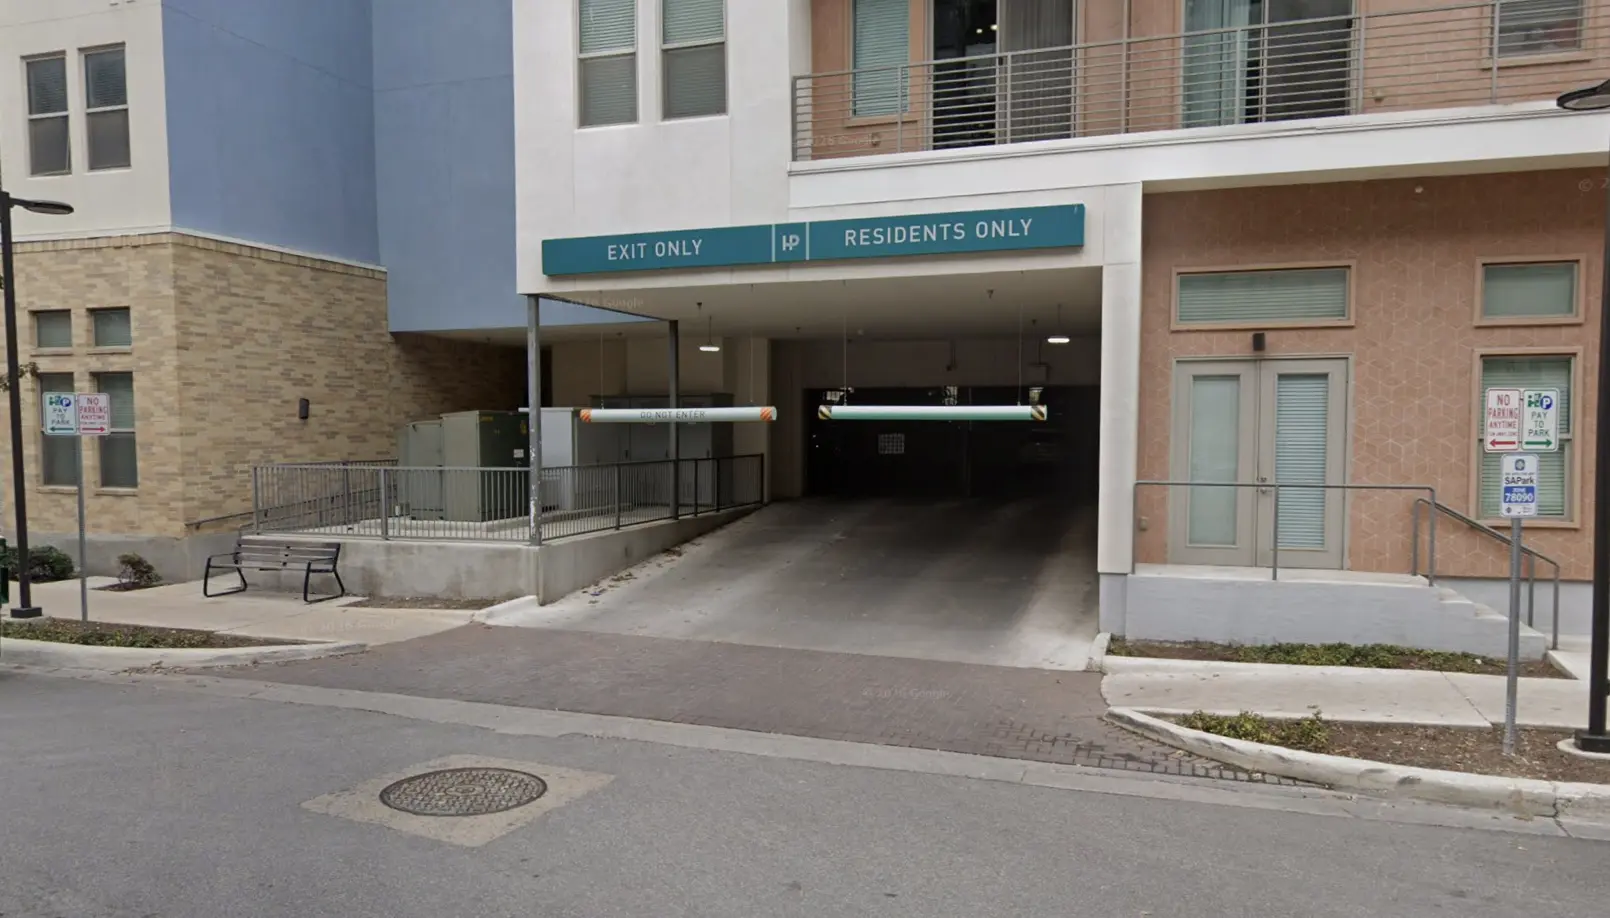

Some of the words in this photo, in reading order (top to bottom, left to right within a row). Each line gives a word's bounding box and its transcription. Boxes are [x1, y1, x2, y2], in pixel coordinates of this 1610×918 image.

[845, 223, 965, 246] RESIDENTS
[976, 218, 1033, 238] ONLY
[607, 243, 647, 260] EXIT
[655, 239, 703, 257] ONLY
[87, 397, 99, 405] NO
[1496, 394, 1510, 406] NO
[79, 406, 107, 414] PARKING
[1488, 408, 1519, 419] PARKING
[640, 411, 652, 419] DO
[655, 411, 673, 419] NOT
[676, 411, 706, 419] ENTER
[1531, 411, 1548, 419] PAY
[1489, 420, 1517, 429] ANYTIME
[1534, 420, 1545, 428] TO
[1528, 429, 1550, 437] PARK
[1504, 476, 1535, 485] SAPark
[1505, 492, 1534, 502] 78090
